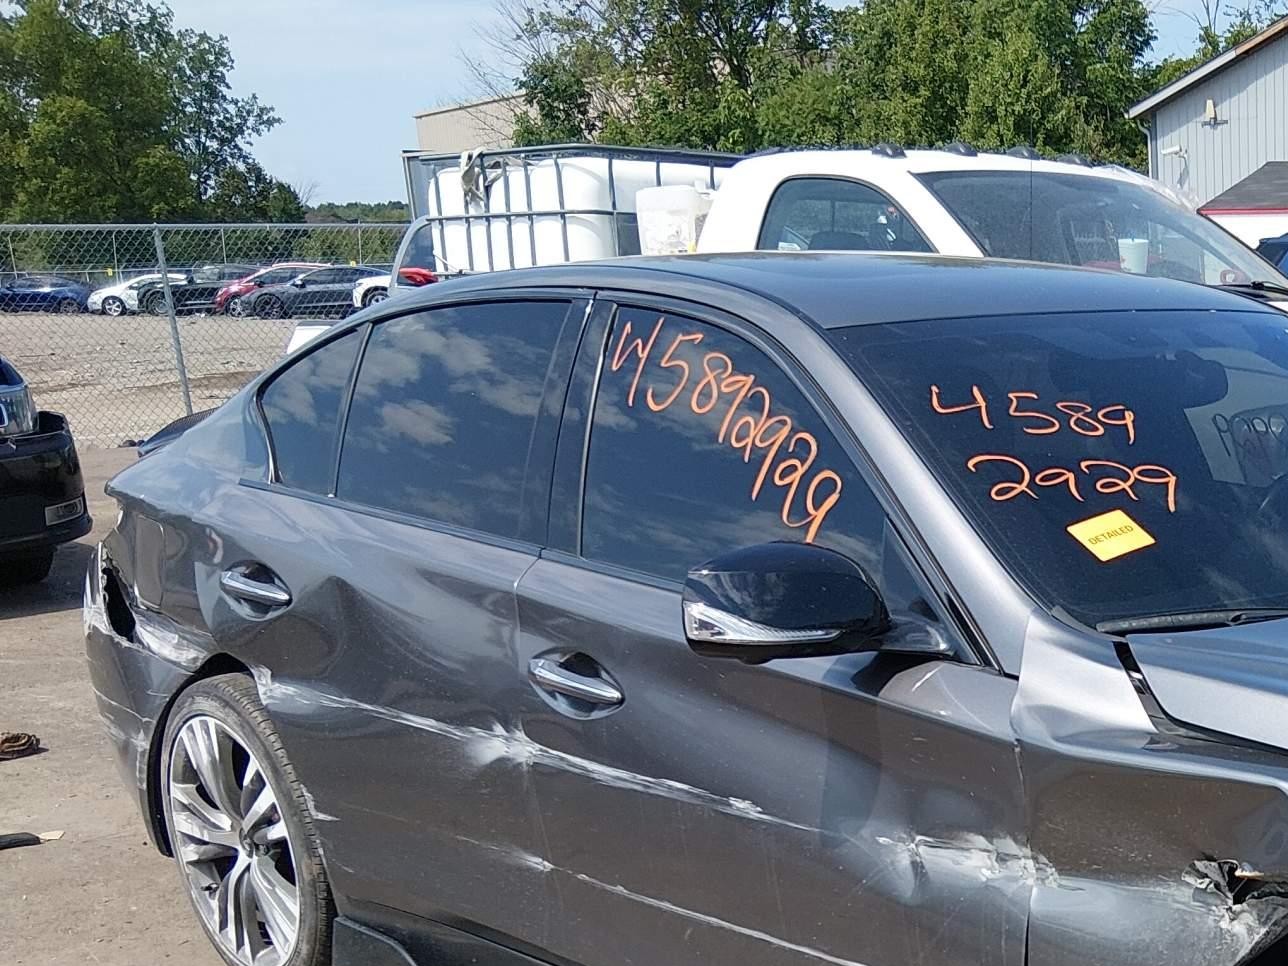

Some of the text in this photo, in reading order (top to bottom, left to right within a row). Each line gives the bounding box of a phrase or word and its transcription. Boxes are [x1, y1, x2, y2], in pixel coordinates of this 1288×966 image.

[930, 384, 1136, 445] 4589
[967, 454, 1177, 513] 2929
[1088, 525, 1134, 545] DETAILED
